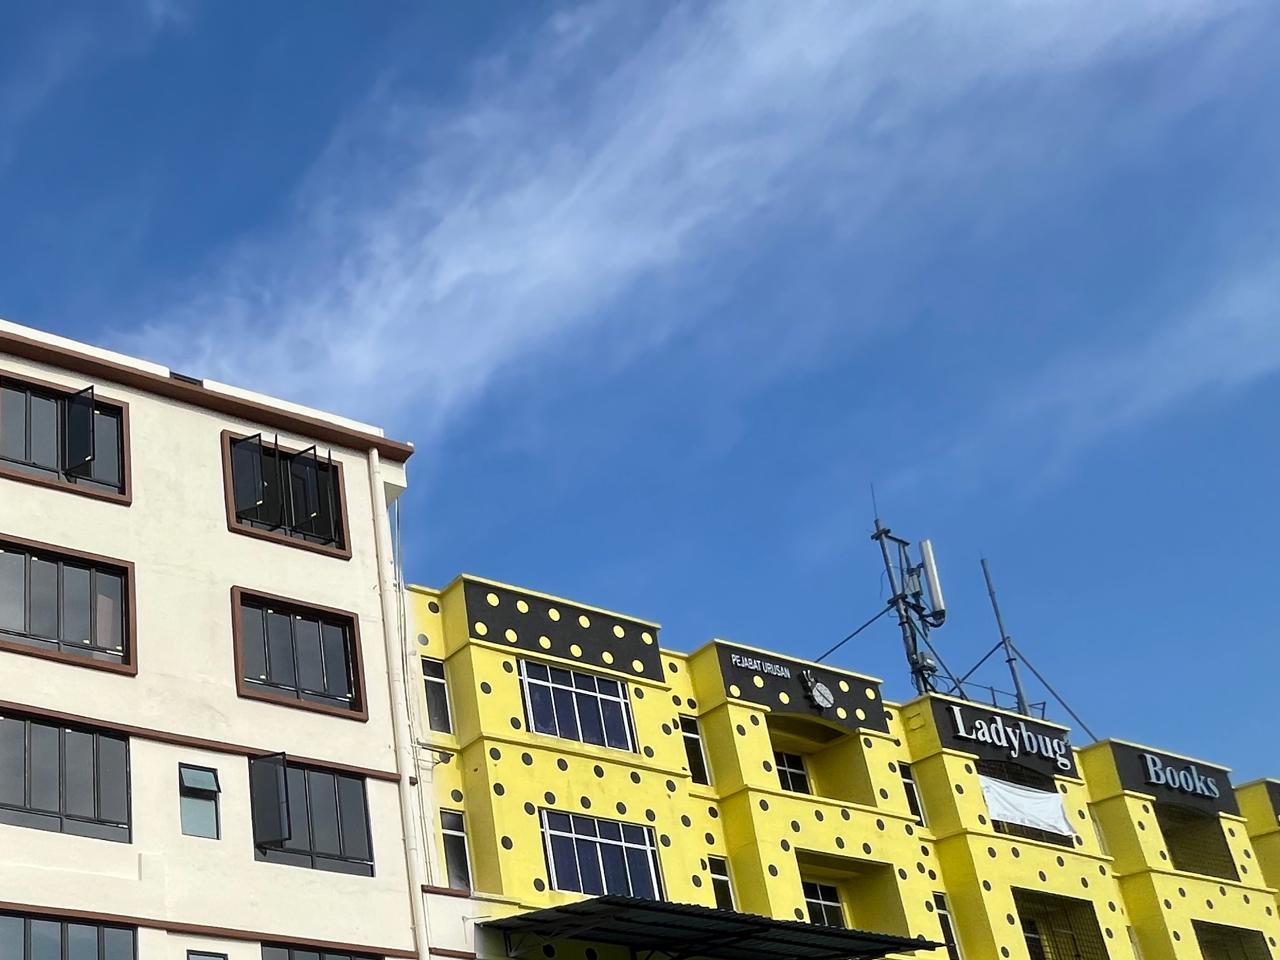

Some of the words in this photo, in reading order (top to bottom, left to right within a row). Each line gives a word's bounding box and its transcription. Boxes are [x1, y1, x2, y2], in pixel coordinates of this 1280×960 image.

[731, 654, 761, 671] PEJABAT
[762, 662, 791, 678] URUSAN
[950, 705, 1071, 770] Ladybug
[1143, 753, 1220, 798] Books
